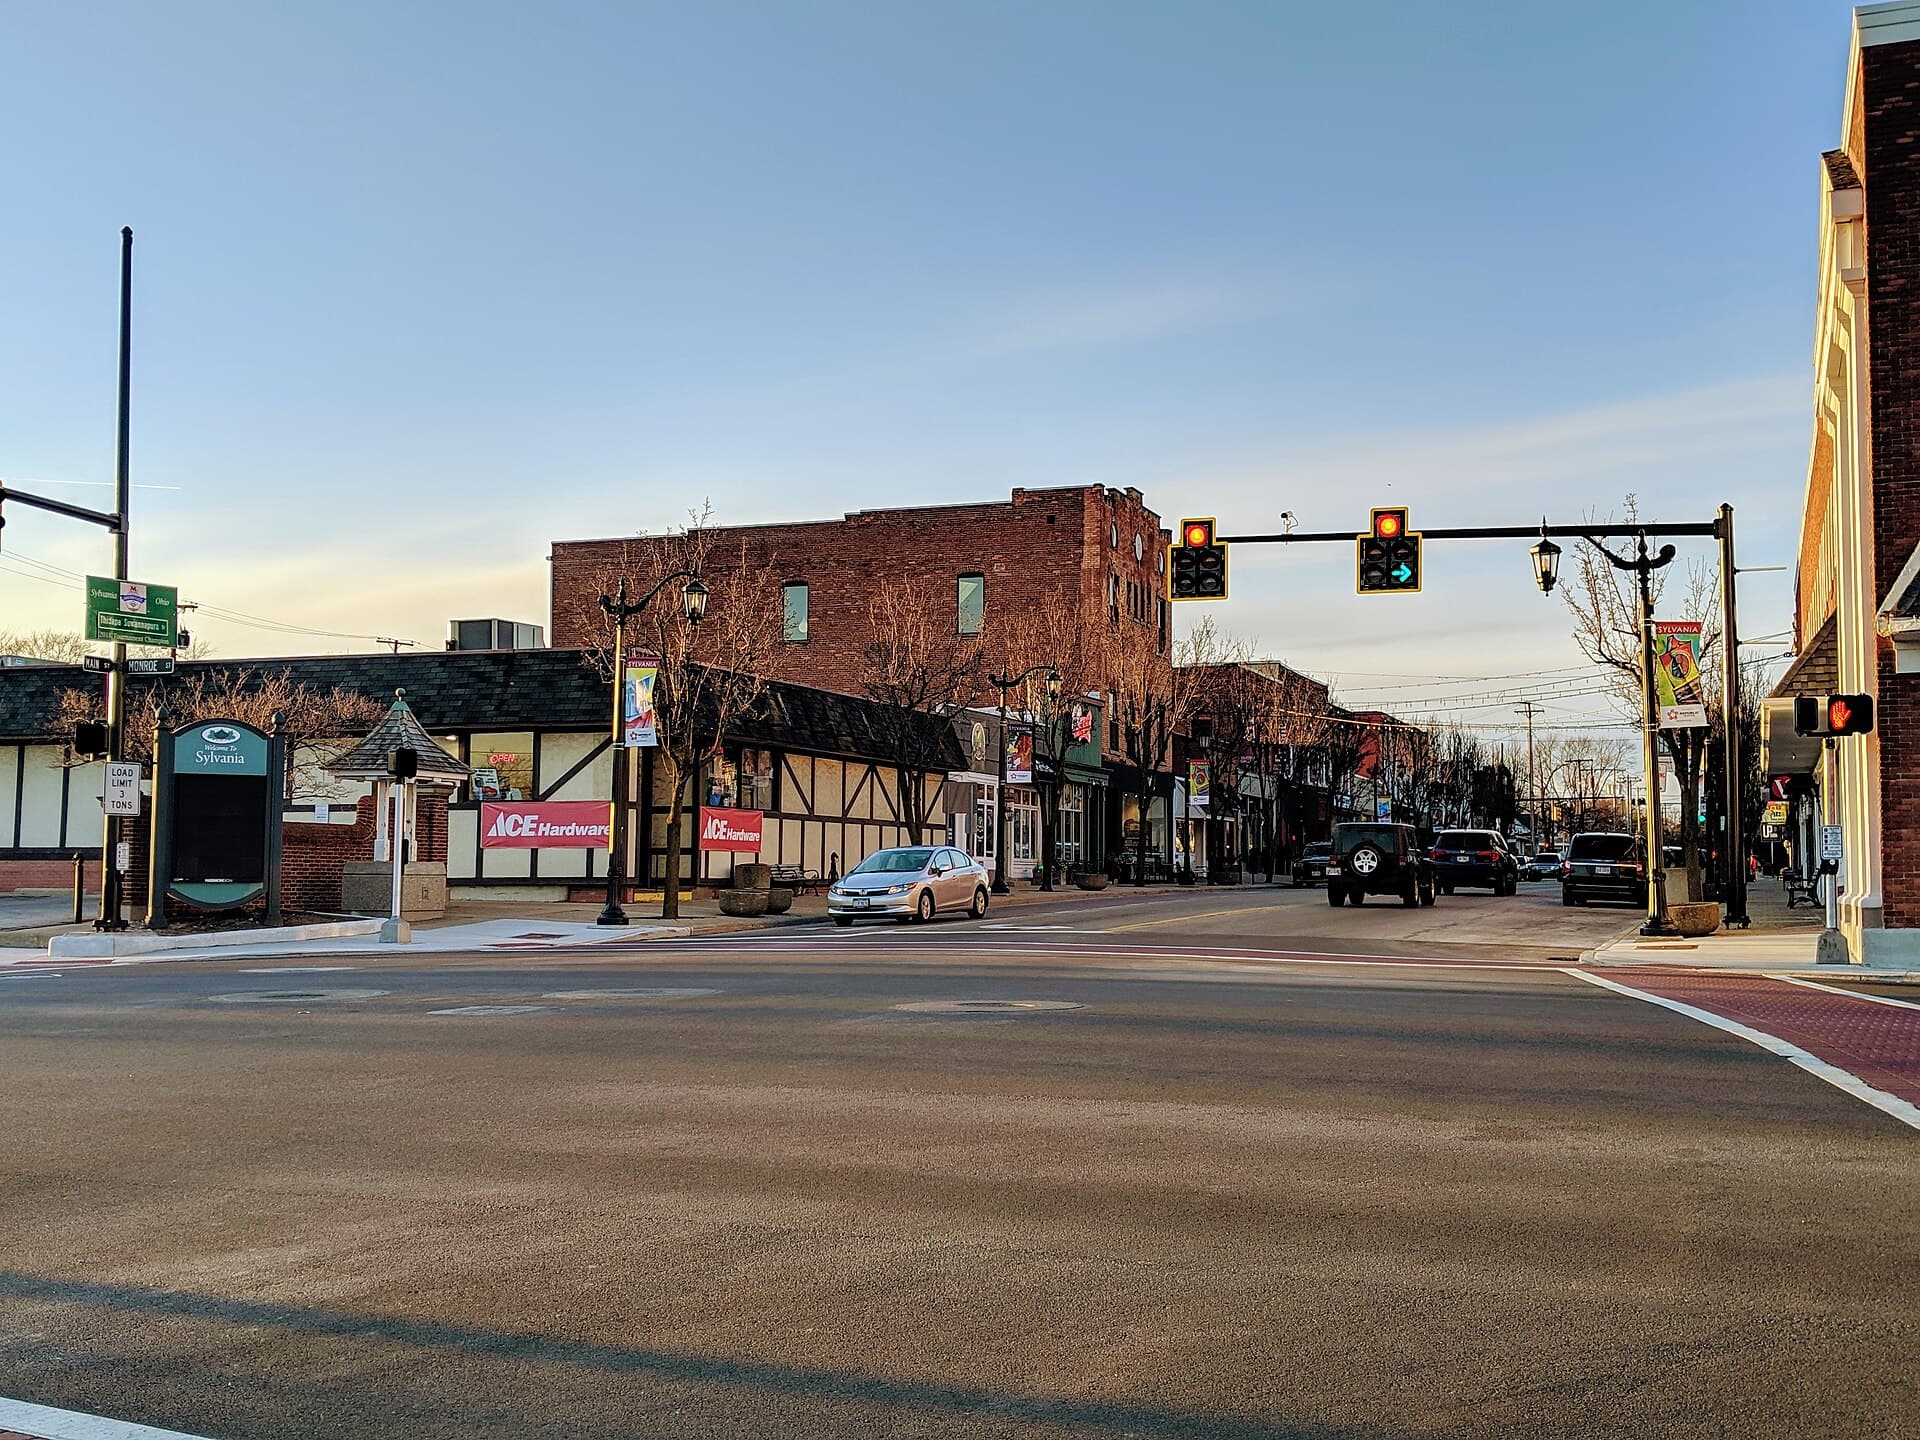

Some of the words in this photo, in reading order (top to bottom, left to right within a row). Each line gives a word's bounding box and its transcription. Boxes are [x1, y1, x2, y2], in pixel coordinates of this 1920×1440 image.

[90, 588, 118, 600] Sylvania
[155, 597, 170, 606] Ohio
[1657, 625, 1699, 633] SYLVANIA
[85, 658, 100, 669] MAIN
[128, 660, 158, 671] MONROE
[165, 661, 171, 669] ST
[628, 660, 657, 668] SYLVANIA
[195, 750, 245, 766] Sylvania
[490, 752, 516, 764] OPEN
[111, 768, 134, 777] LOAD
[111, 779, 133, 788] LIMIT
[119, 790, 125, 798] 3
[111, 800, 133, 810] TONS
[487, 810, 539, 837] ACE
[537, 822, 610, 837] Hardware
[702, 815, 728, 840] ACE
[726, 827, 761, 842] Hardware
